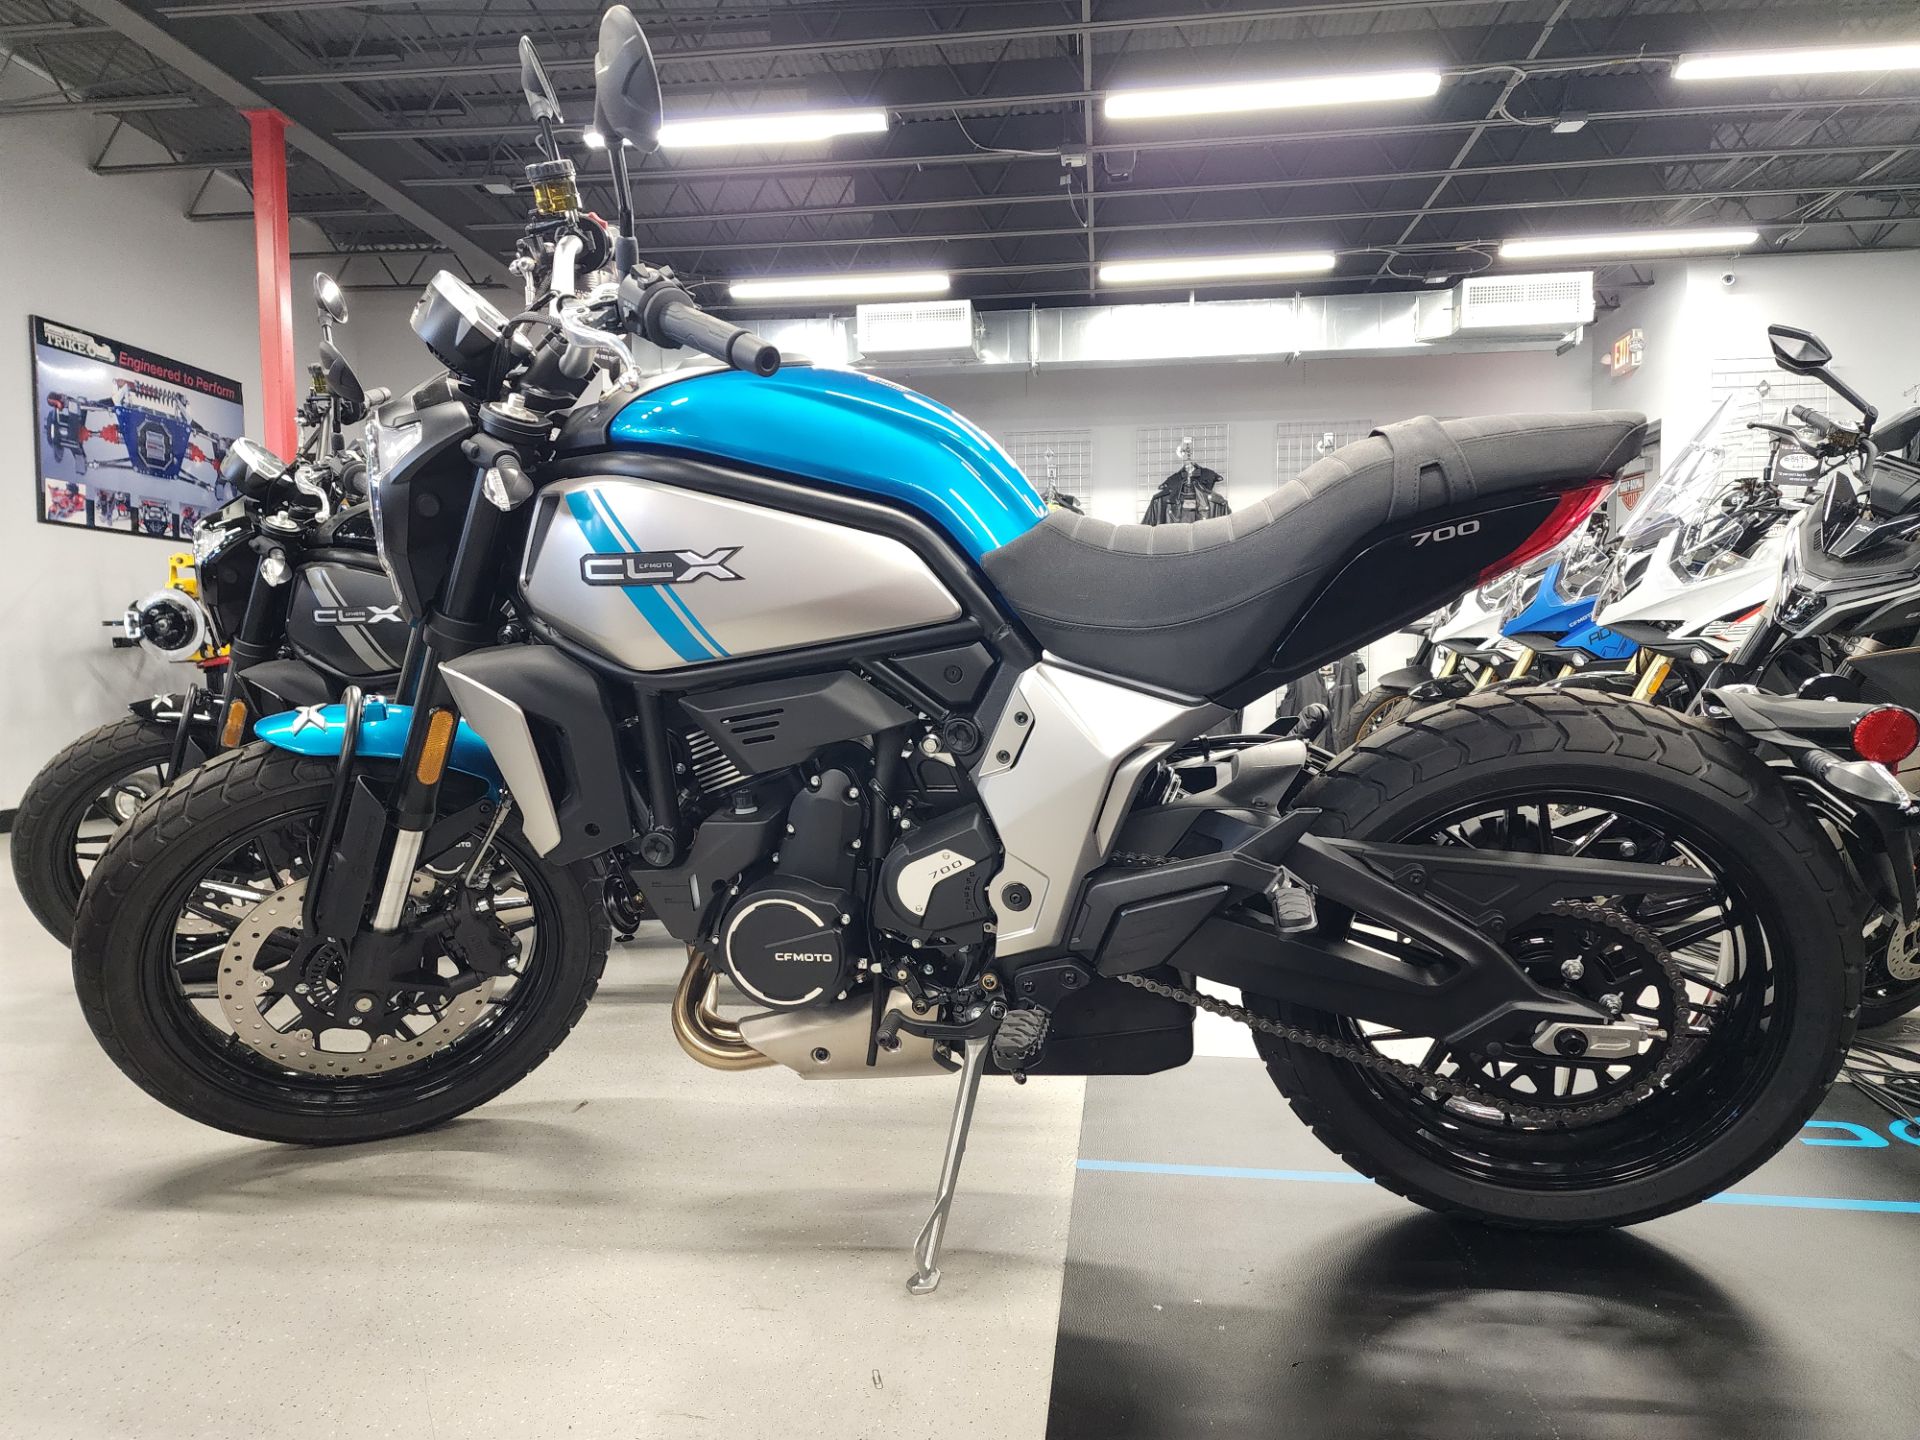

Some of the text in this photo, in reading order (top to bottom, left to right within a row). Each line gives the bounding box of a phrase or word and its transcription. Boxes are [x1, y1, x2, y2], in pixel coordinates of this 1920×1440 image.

[45, 333, 88, 355] TRIKE
[119, 351, 235, 399] Engineered to Perform
[1410, 520, 1480, 547] 700
[639, 561, 673, 569] CFMOTO
[928, 860, 963, 880] 700
[774, 952, 833, 963] CFMOTO
